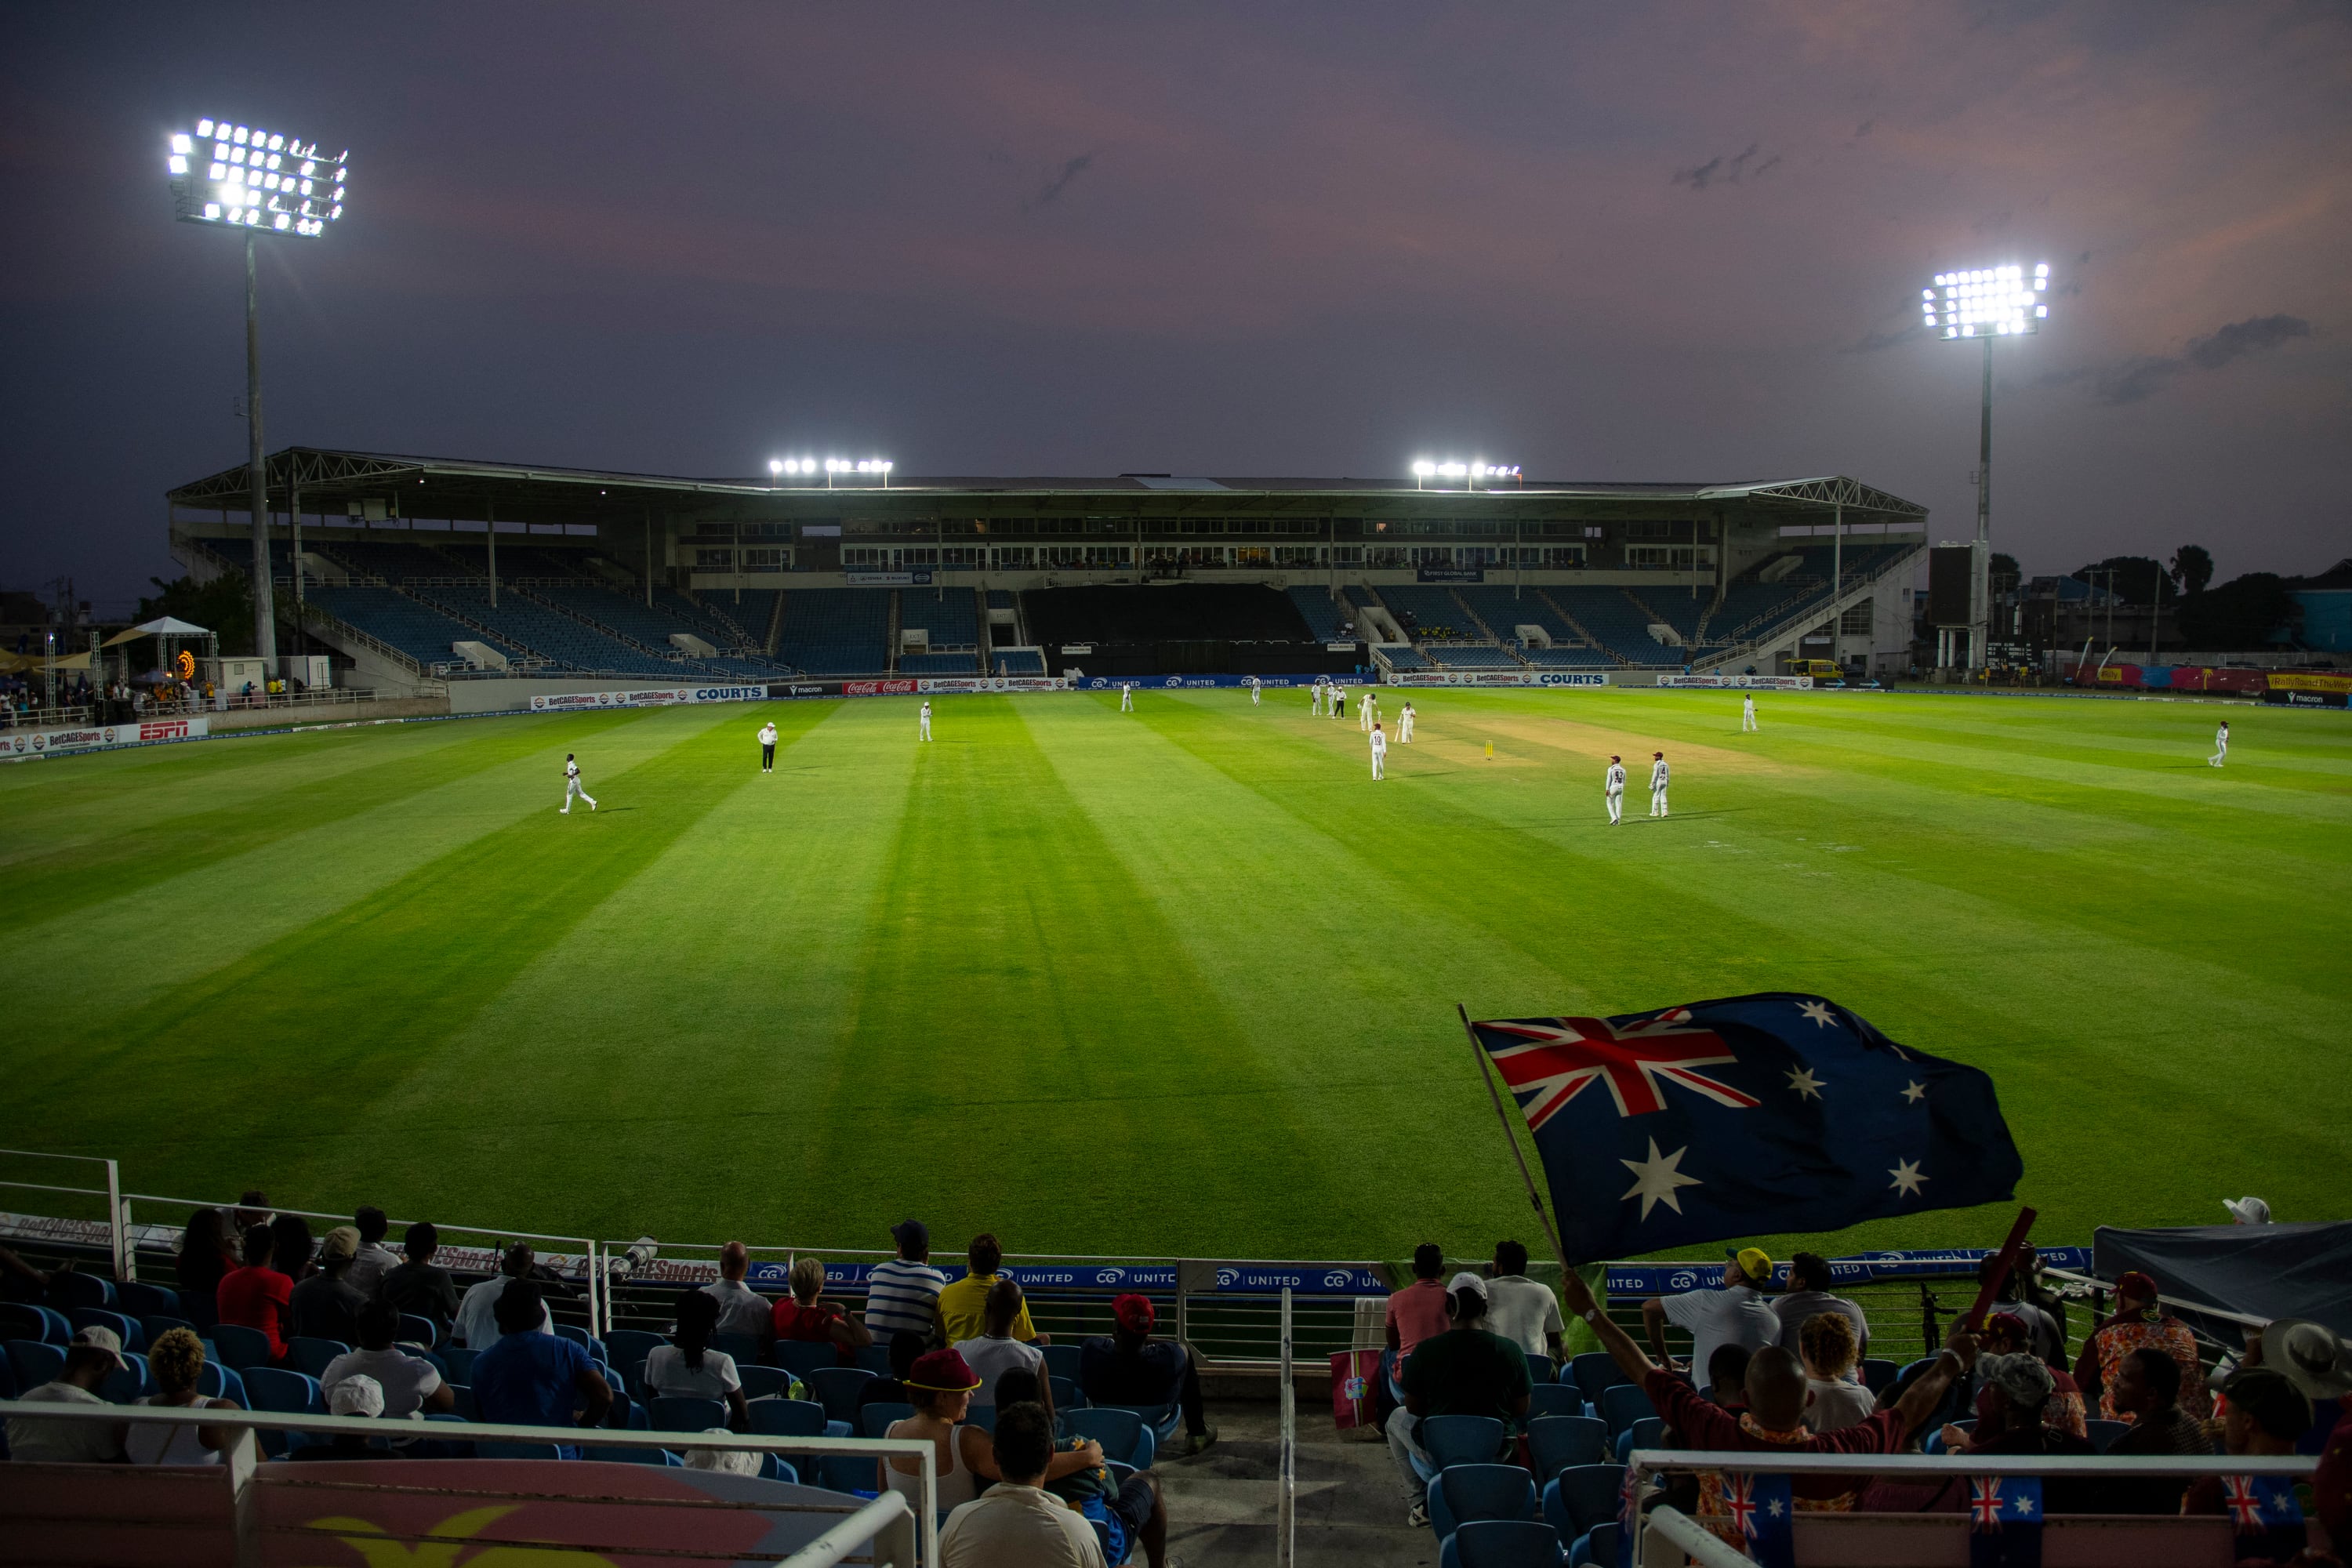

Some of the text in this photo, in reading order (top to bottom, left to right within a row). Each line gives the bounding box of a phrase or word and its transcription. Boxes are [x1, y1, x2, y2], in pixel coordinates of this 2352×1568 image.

[933, 680, 976, 688] BetCAGESports
[1540, 674, 1604, 684] COURTS
[630, 691, 674, 701] BetCAGESports
[696, 687, 762, 700] COURTS
[549, 695, 596, 706] BetCAGESports
[140, 720, 189, 740] ESPN
[49, 731, 100, 746] BetCAGESports
[1831, 1265, 1860, 1275] ITED
[1022, 1274, 1073, 1283] UNITED
[1247, 1276, 1301, 1286] UNITED
